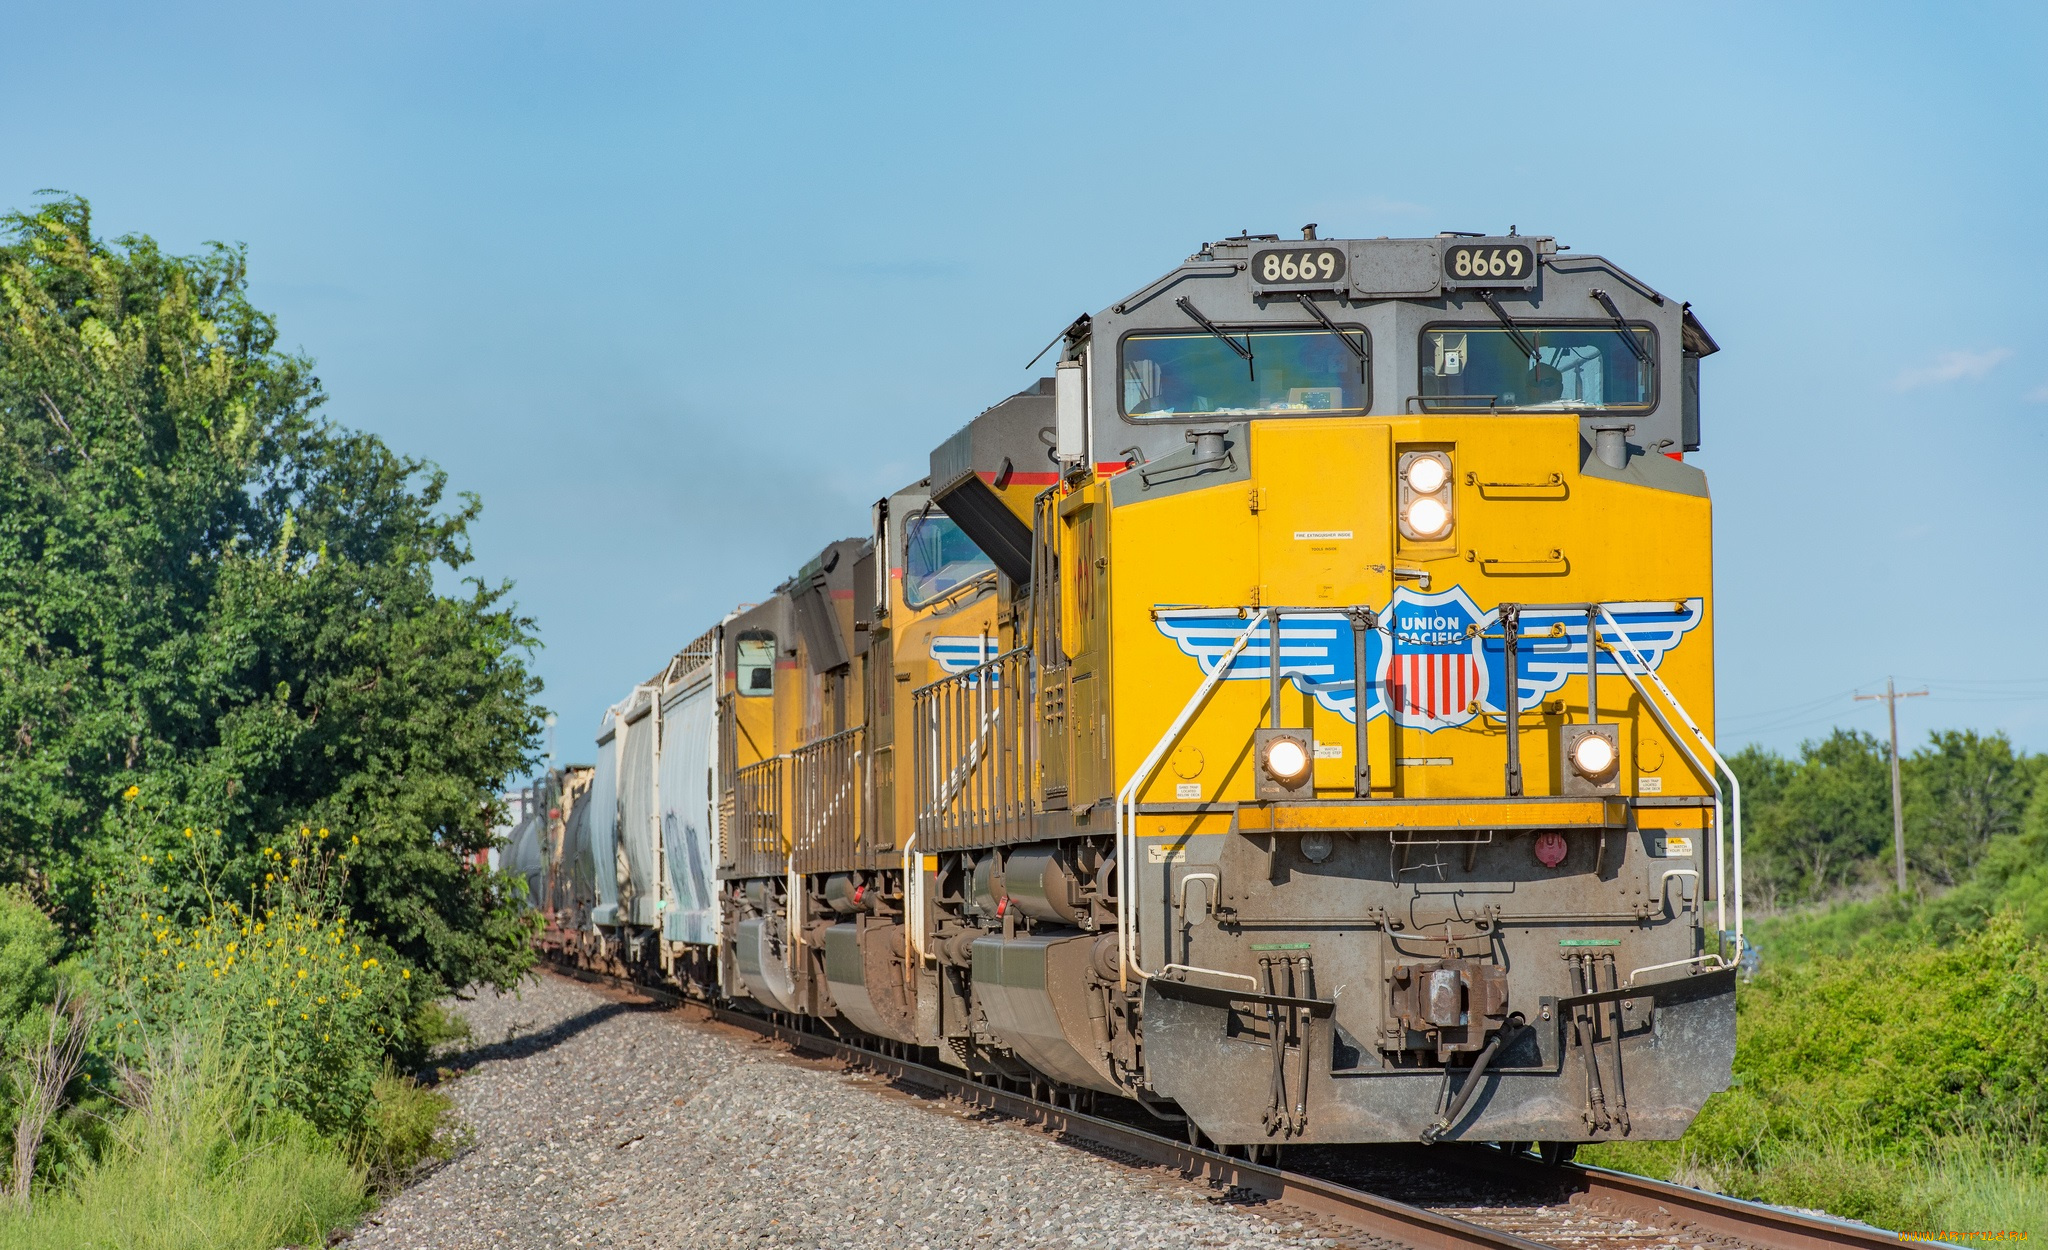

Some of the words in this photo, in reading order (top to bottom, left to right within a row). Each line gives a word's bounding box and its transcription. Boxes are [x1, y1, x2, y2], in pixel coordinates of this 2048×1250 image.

[1263, 252, 1335, 281] 8669
[1455, 249, 1523, 277] 8669
[1401, 616, 1459, 630] UNION
[1398, 632, 1462, 646] PACIFIC
